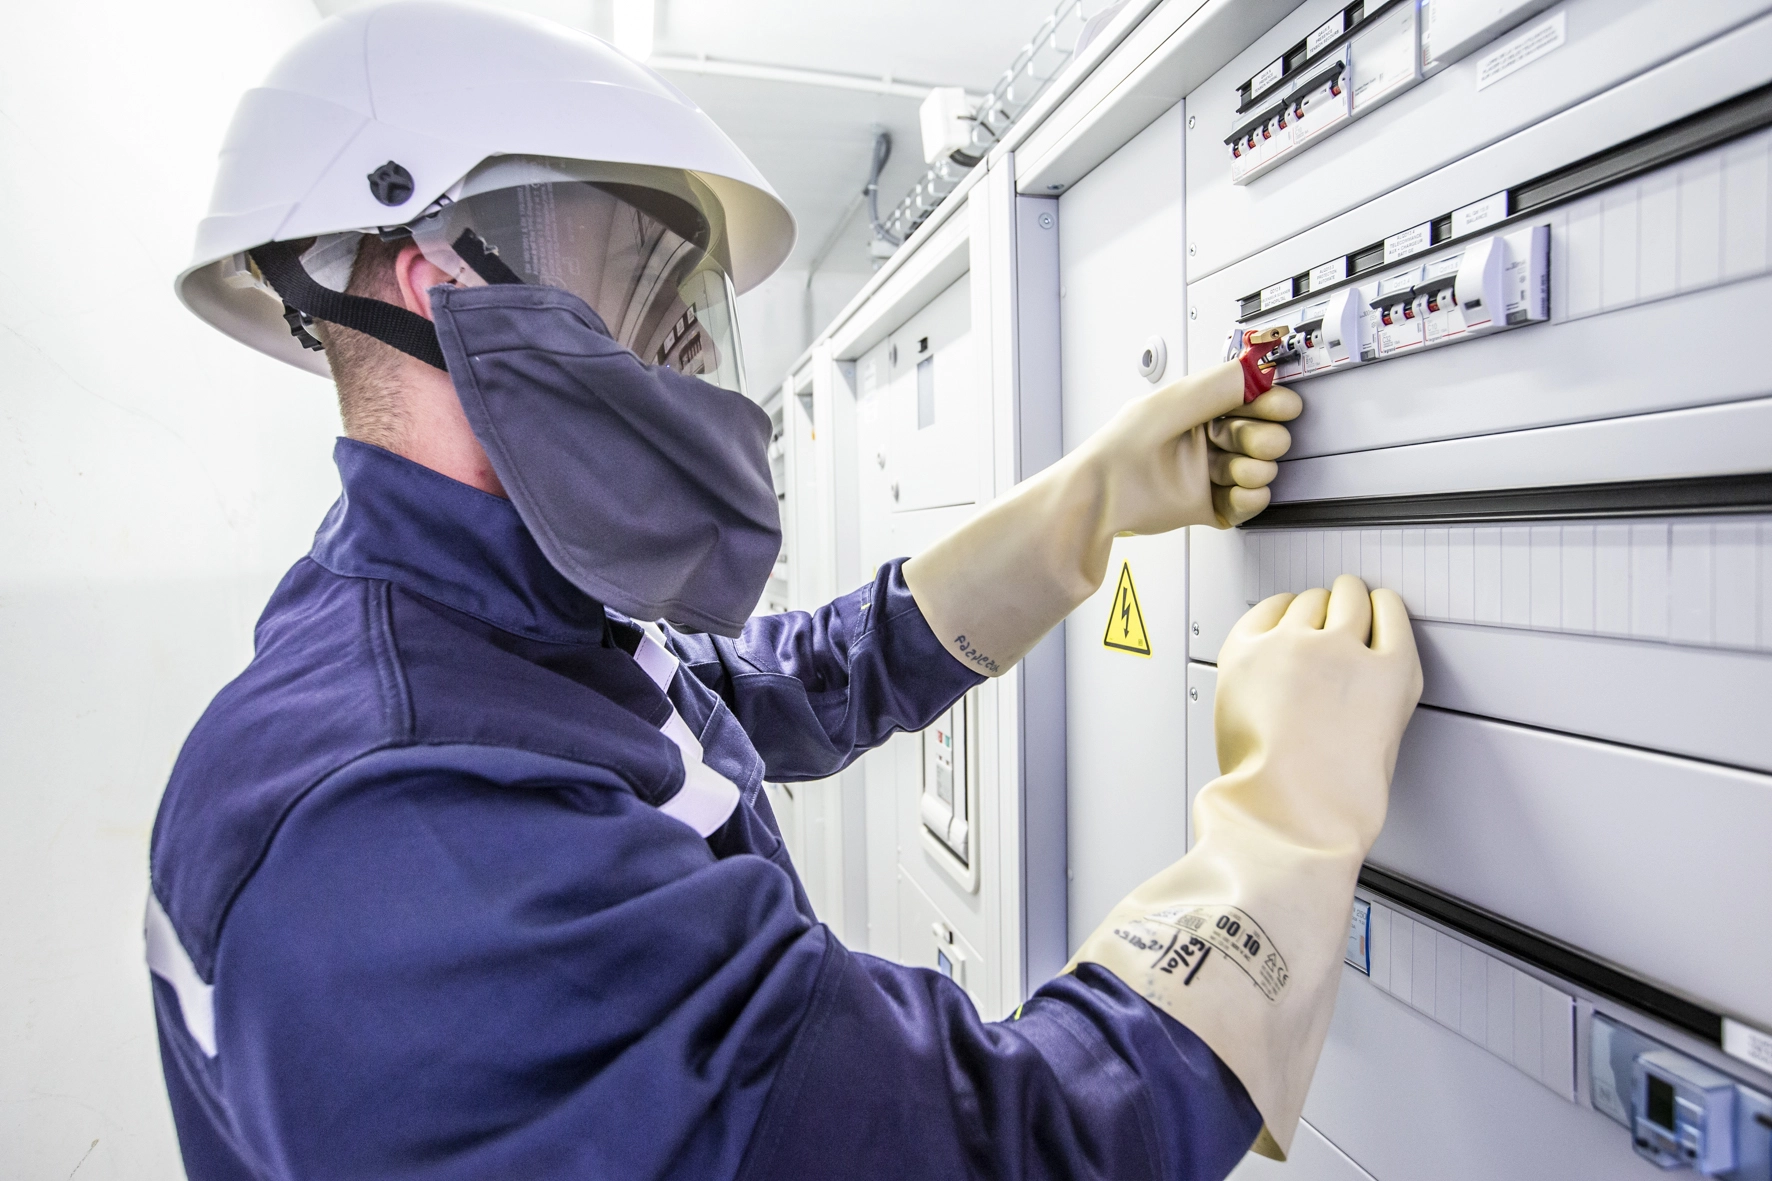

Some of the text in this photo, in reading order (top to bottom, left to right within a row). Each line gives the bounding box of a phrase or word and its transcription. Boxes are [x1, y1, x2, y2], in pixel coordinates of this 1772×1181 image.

[1389, 232, 1422, 249] TELECOMMANDE
[1427, 323, 1438, 332] C10
[1382, 335, 1392, 344] C32
[1216, 915, 1241, 937] 00
[1242, 933, 1261, 957] 10
